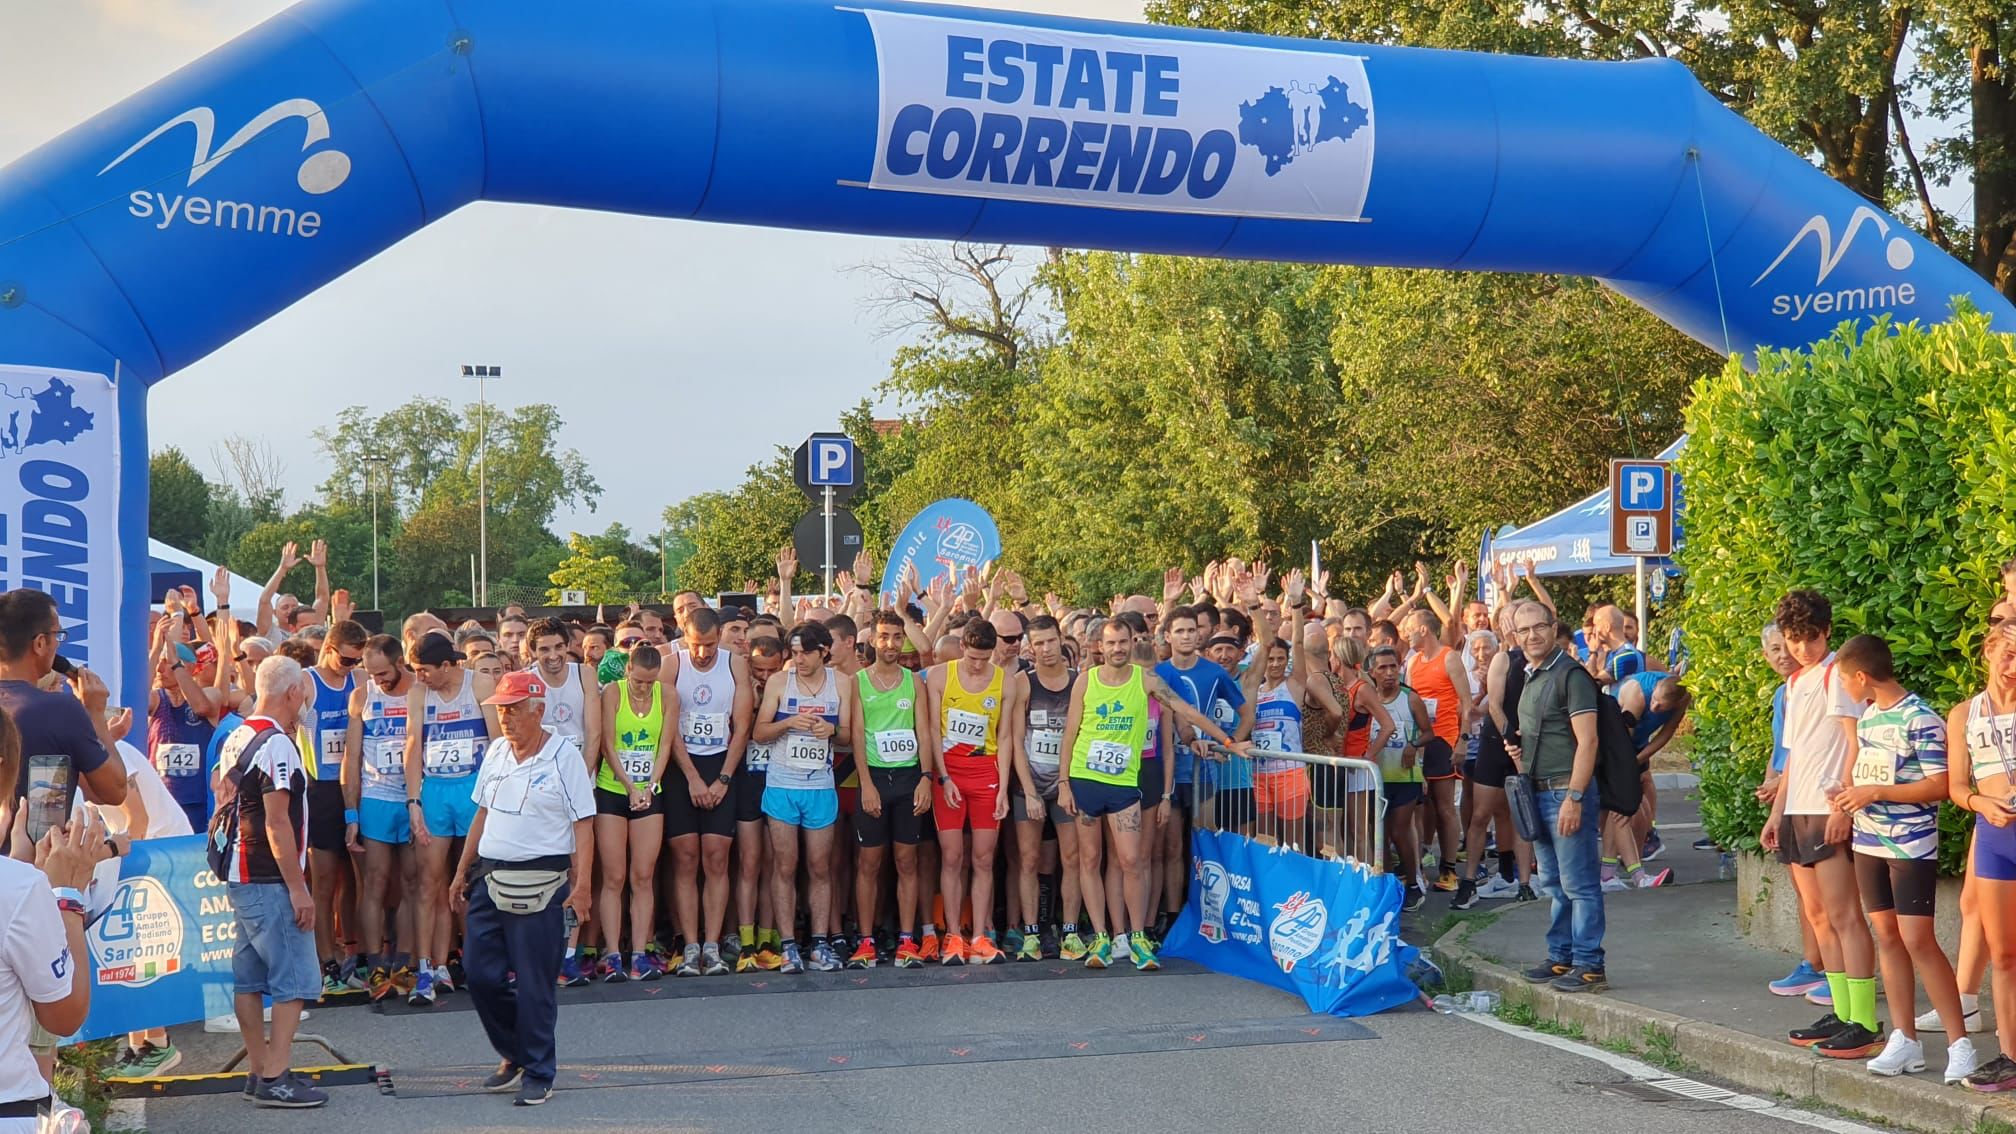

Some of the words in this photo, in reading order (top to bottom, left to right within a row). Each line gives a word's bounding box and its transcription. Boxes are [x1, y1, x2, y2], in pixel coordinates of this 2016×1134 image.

[946, 34, 1179, 117] ESTATE
[886, 104, 1236, 199] CORRENDO
[128, 190, 321, 237] syemme
[1772, 283, 1915, 321] syemme
[820, 443, 846, 480] P
[1630, 472, 1654, 504] P
[19, 459, 90, 668] ENDO
[693, 722, 713, 736] 59
[950, 719, 985, 737] 1072
[1096, 723, 1132, 731] CORRENDO
[327, 740, 346, 754] 11
[790, 746, 825, 761] 1063
[881, 739, 915, 753] 1069
[163, 753, 194, 767] 142
[440, 750, 460, 763] 73
[751, 749, 770, 762] 24
[1096, 750, 1124, 765] 126
[624, 760, 651, 774] 158
[1854, 762, 1889, 782] 1045
[193, 870, 227, 888] CO
[1228, 872, 1252, 892] ORSA
[199, 895, 235, 915] AM
[136, 911, 168, 921] Gruppo
[135, 919, 170, 931] Amatori
[202, 924, 213, 943] E
[136, 929, 172, 941] Podismo
[104, 942, 175, 963] Saronno
[101, 970, 114, 982] dal
[114, 966, 135, 980] 1974
